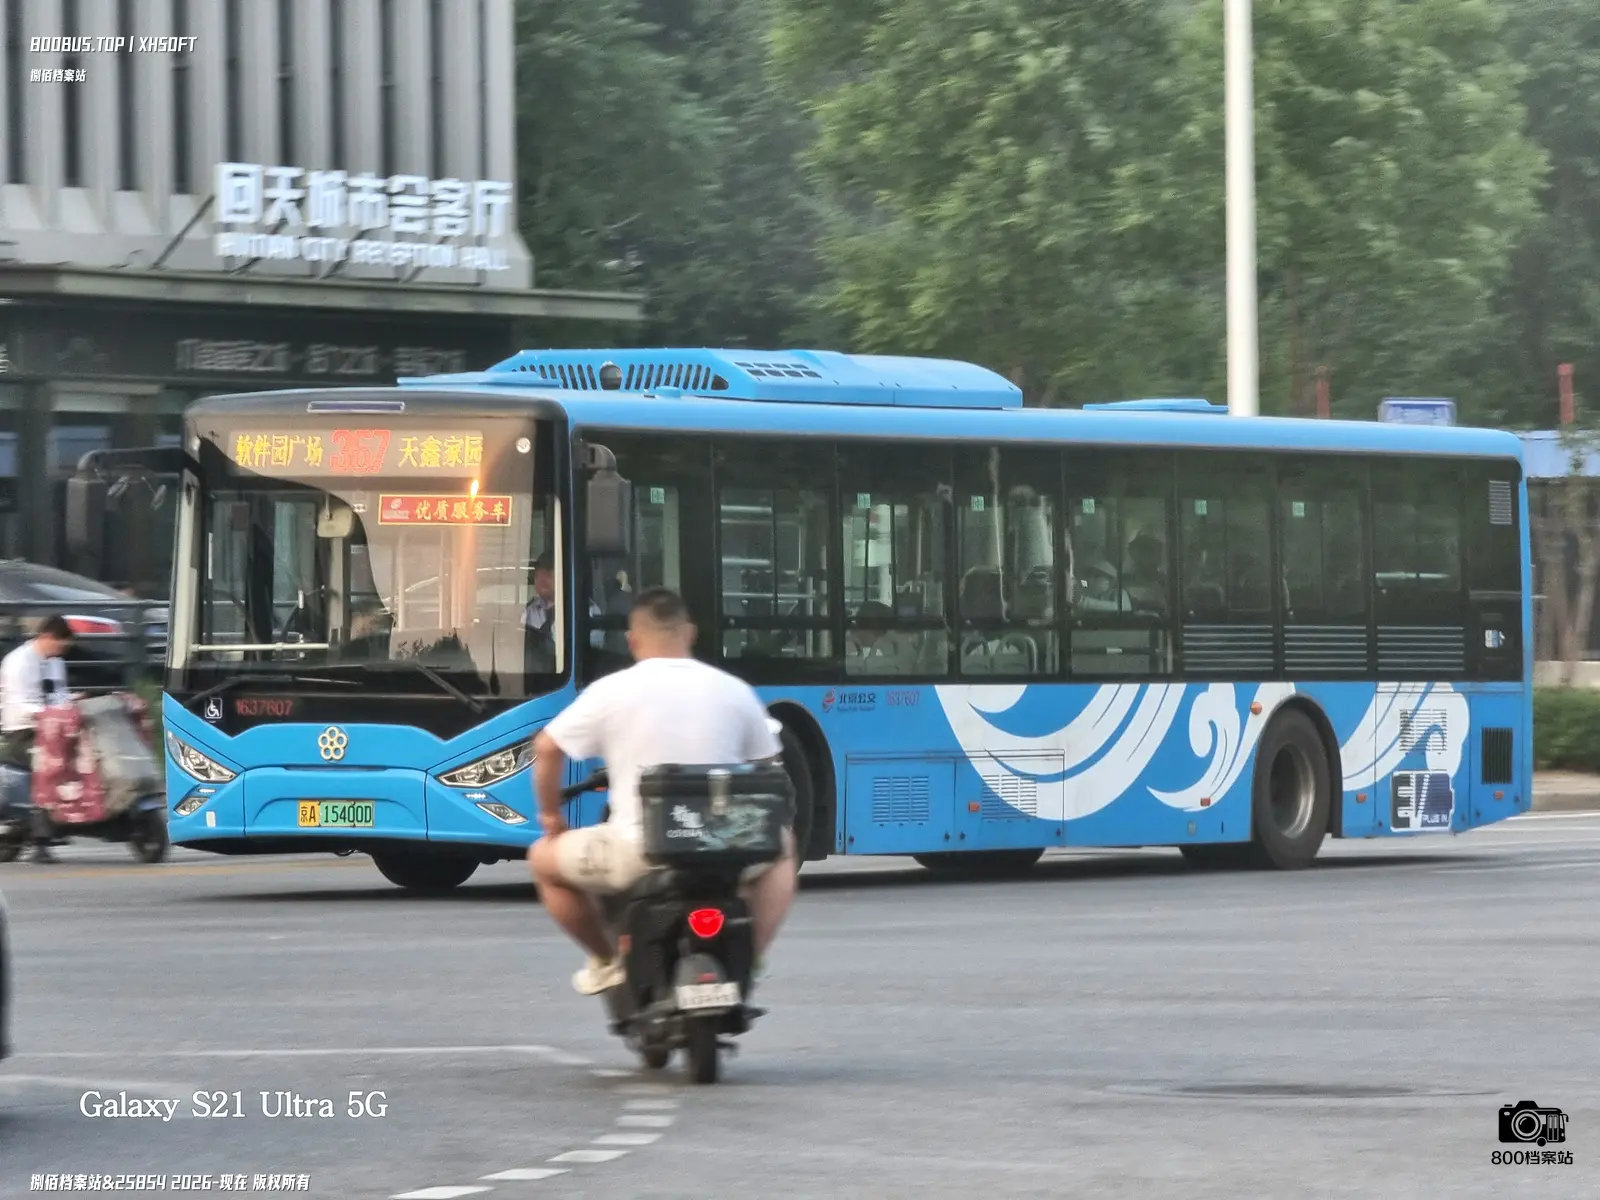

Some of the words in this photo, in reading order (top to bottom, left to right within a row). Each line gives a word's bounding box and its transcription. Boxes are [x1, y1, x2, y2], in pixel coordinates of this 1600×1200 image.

[235, 434, 324, 468] 软件园广场
[398, 435, 484, 468] 天鑫家园
[415, 499, 507, 522] 优质服务车
